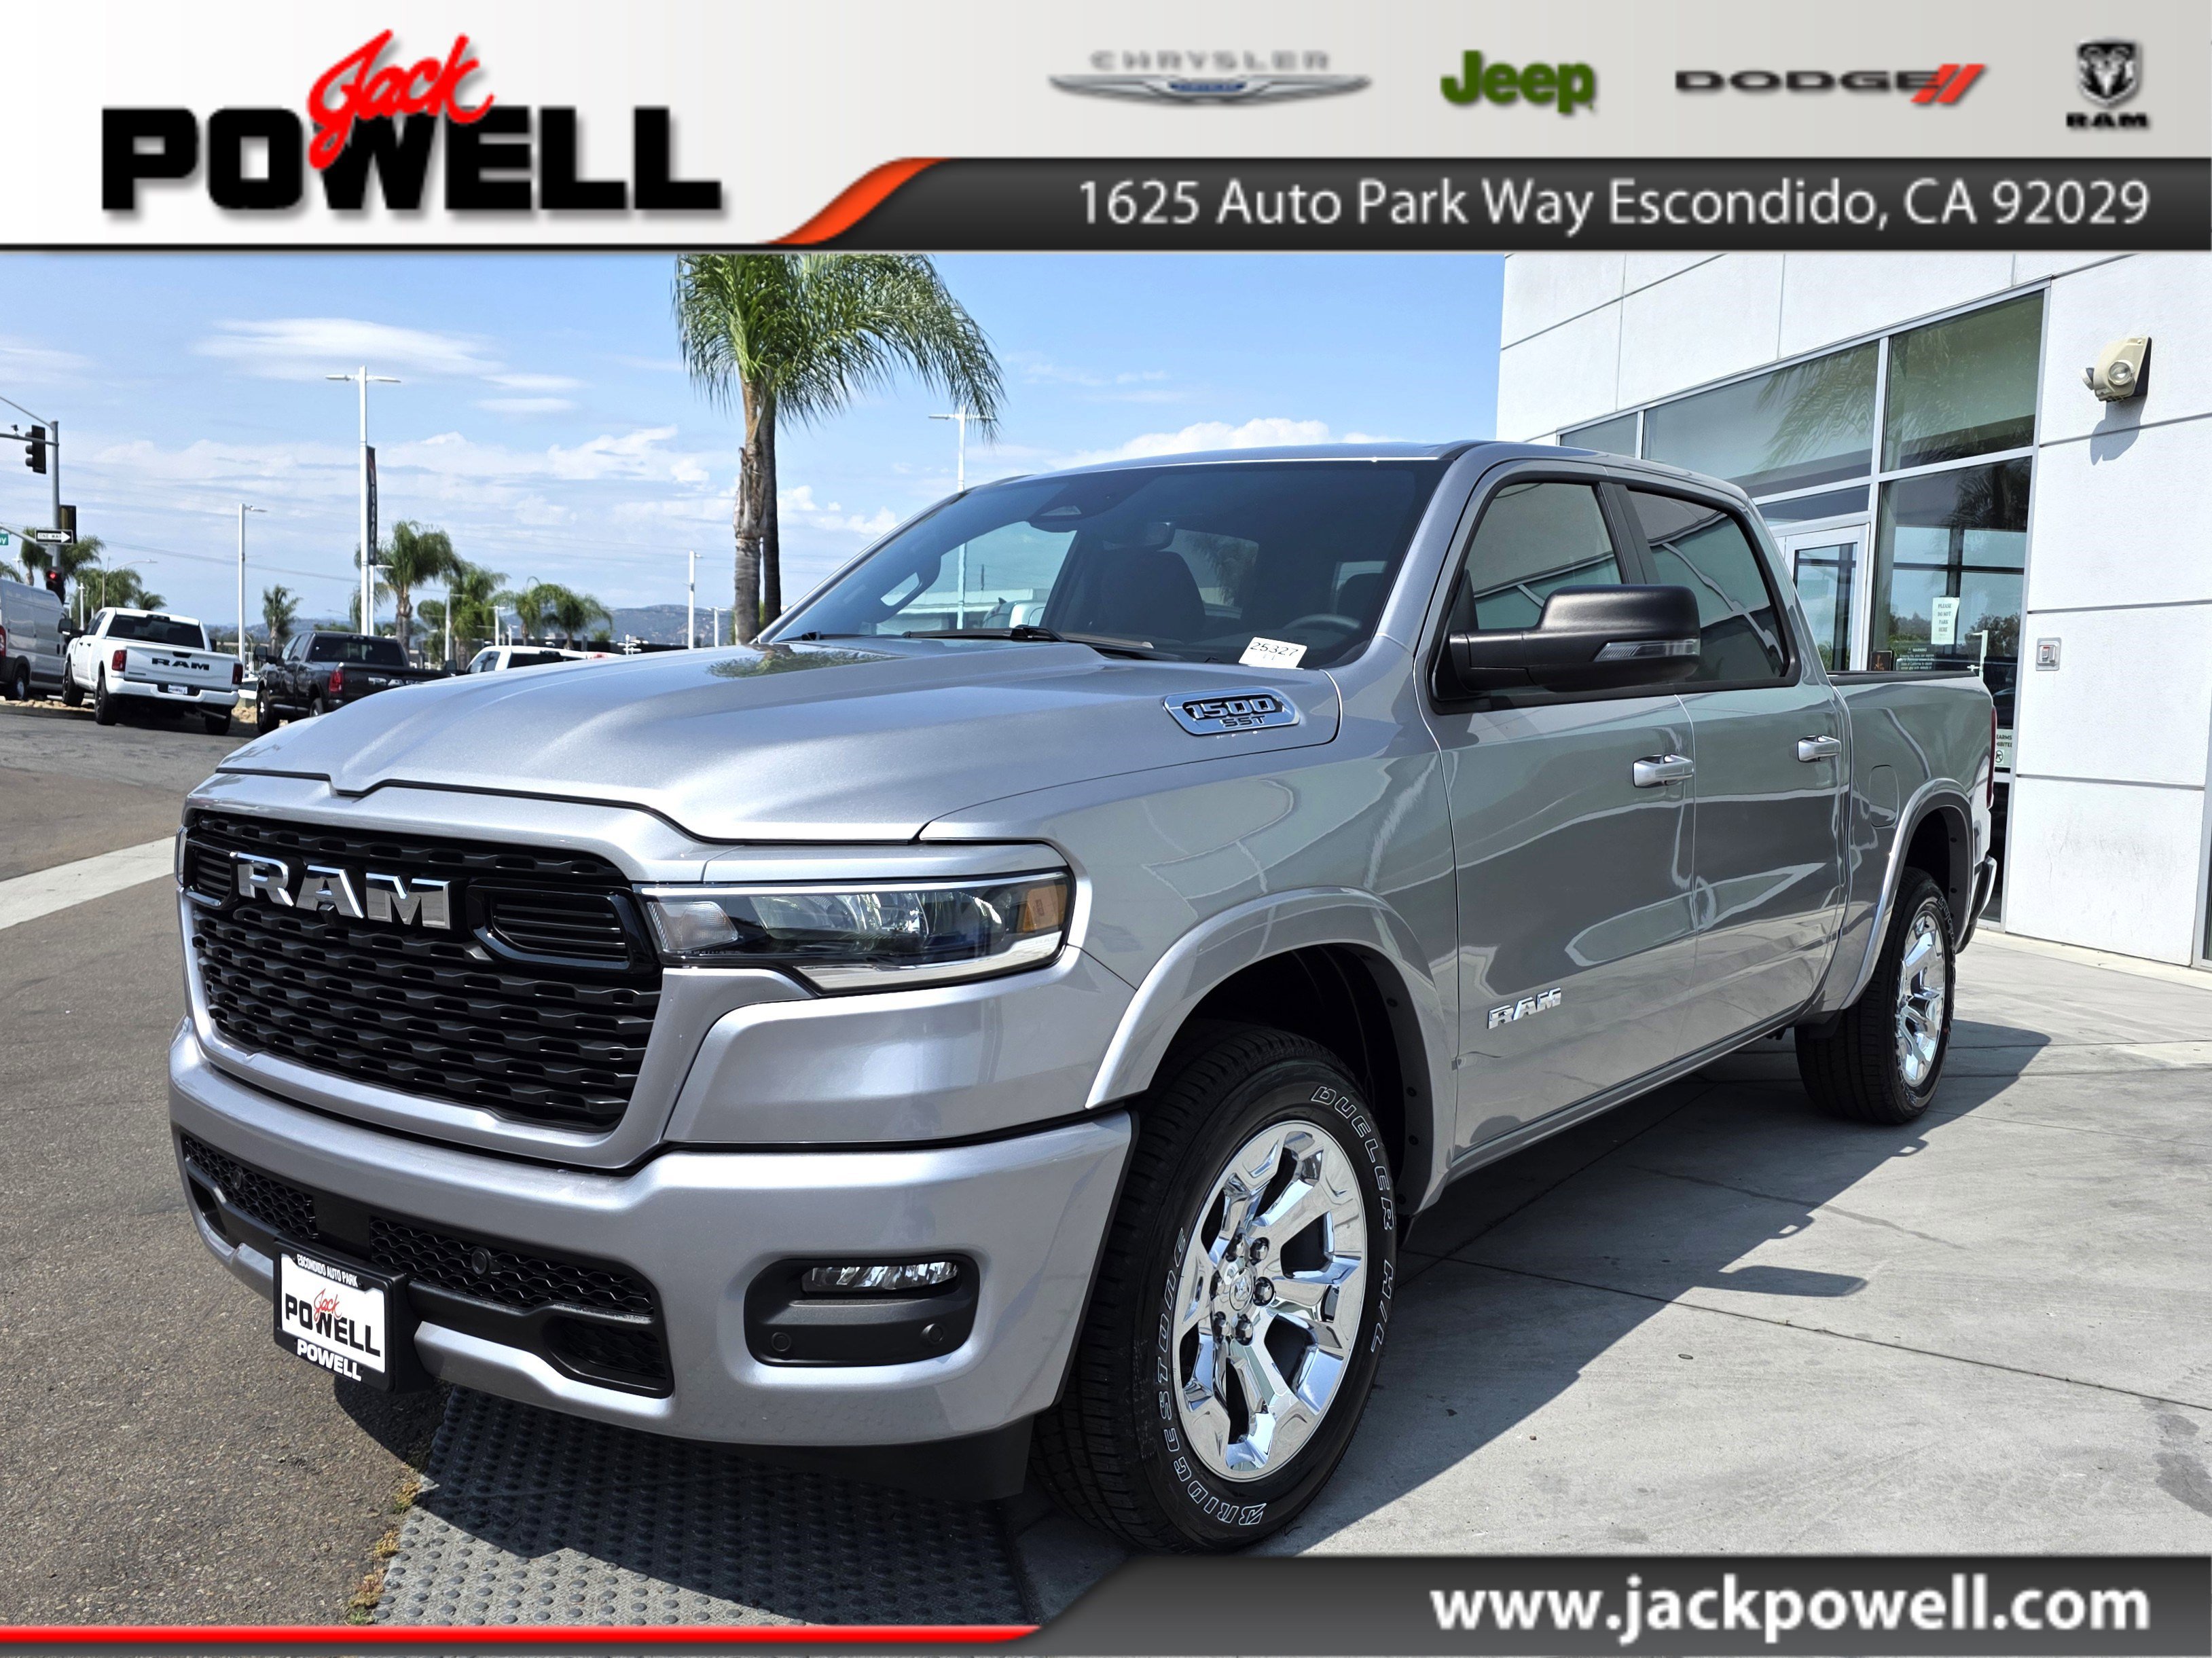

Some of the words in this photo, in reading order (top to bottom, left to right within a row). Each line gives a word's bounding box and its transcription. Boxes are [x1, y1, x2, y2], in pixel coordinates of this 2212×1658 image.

[151, 657, 210, 671] RAM
[1249, 642, 1299, 657] 25327
[1185, 698, 1275, 719] 1500
[230, 851, 450, 929] RAM
[1487, 987, 1562, 1029] RAM
[1311, 1086, 1394, 1231] DUELER
[327, 1266, 342, 1283] AUTO
[342, 1271, 359, 1288] PARK
[285, 1293, 381, 1357] POWELL
[313, 1289, 342, 1321] Jack
[297, 1339, 362, 1382] POWELL
[1155, 1227, 1267, 1526] BRIDGESTONE
